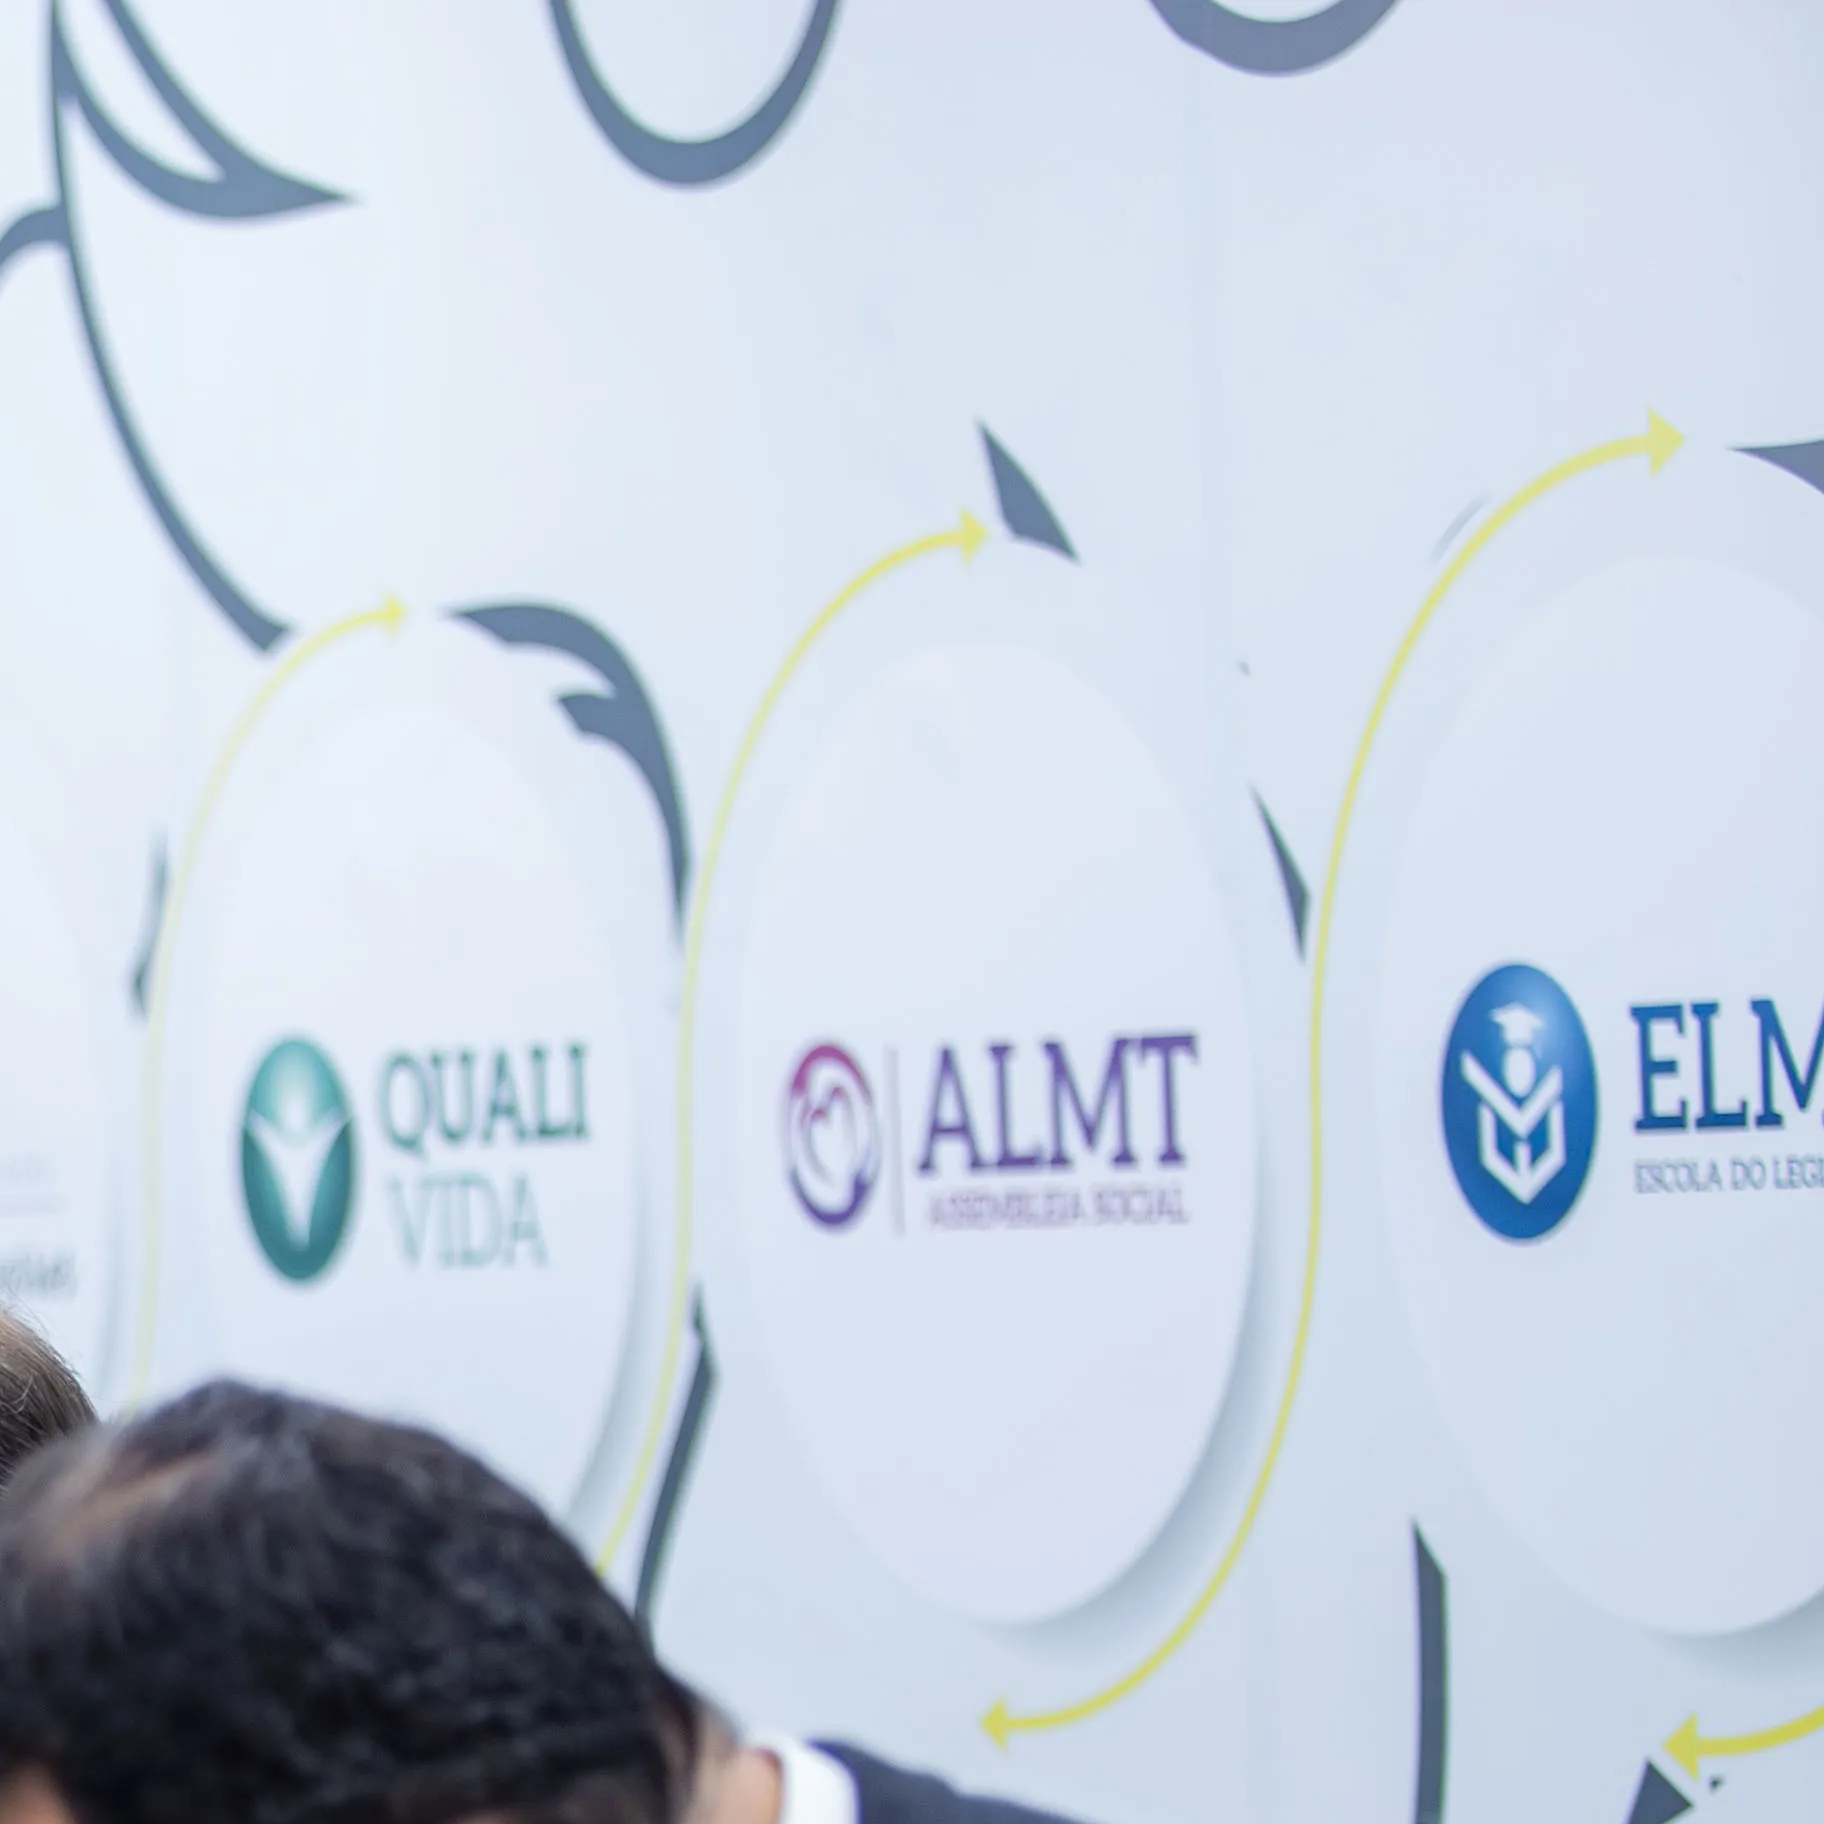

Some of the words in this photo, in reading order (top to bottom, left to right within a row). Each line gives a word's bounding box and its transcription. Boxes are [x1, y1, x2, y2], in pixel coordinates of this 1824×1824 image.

[378, 1045, 590, 1160] QUALI
[917, 1033, 1198, 1171] ALMT
[386, 1172, 550, 1266] VIDA
[1091, 1182, 1191, 1225] SOCIAL
[1635, 1158, 1723, 1193] ESCOLA
[1730, 1156, 1767, 1191] DO
